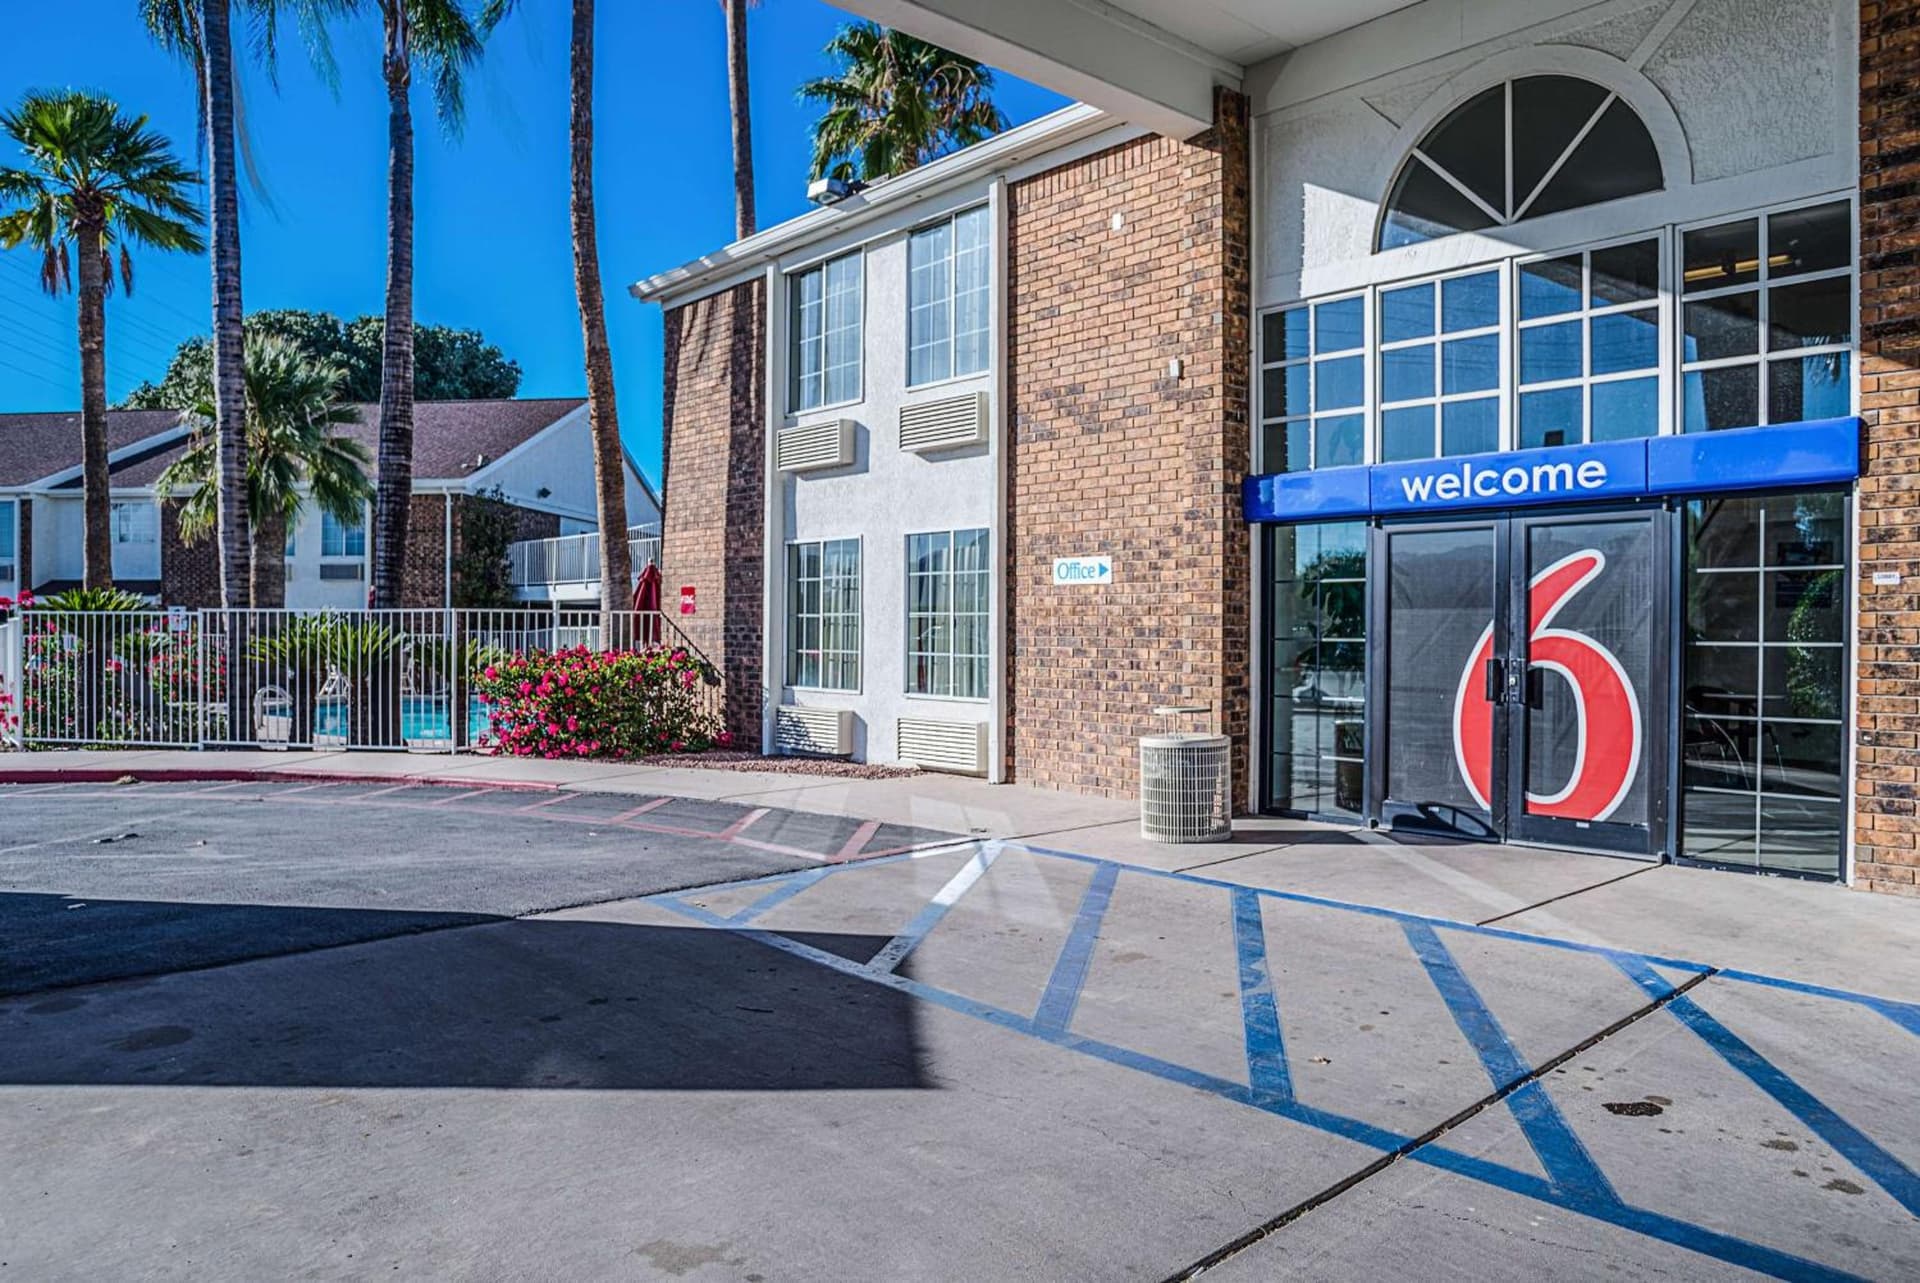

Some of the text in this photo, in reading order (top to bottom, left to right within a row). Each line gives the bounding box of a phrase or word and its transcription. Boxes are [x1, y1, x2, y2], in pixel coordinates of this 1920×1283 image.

[1401, 460, 1607, 502] welcome
[1057, 562, 1096, 580] Office
[1453, 549, 1642, 822] 6
